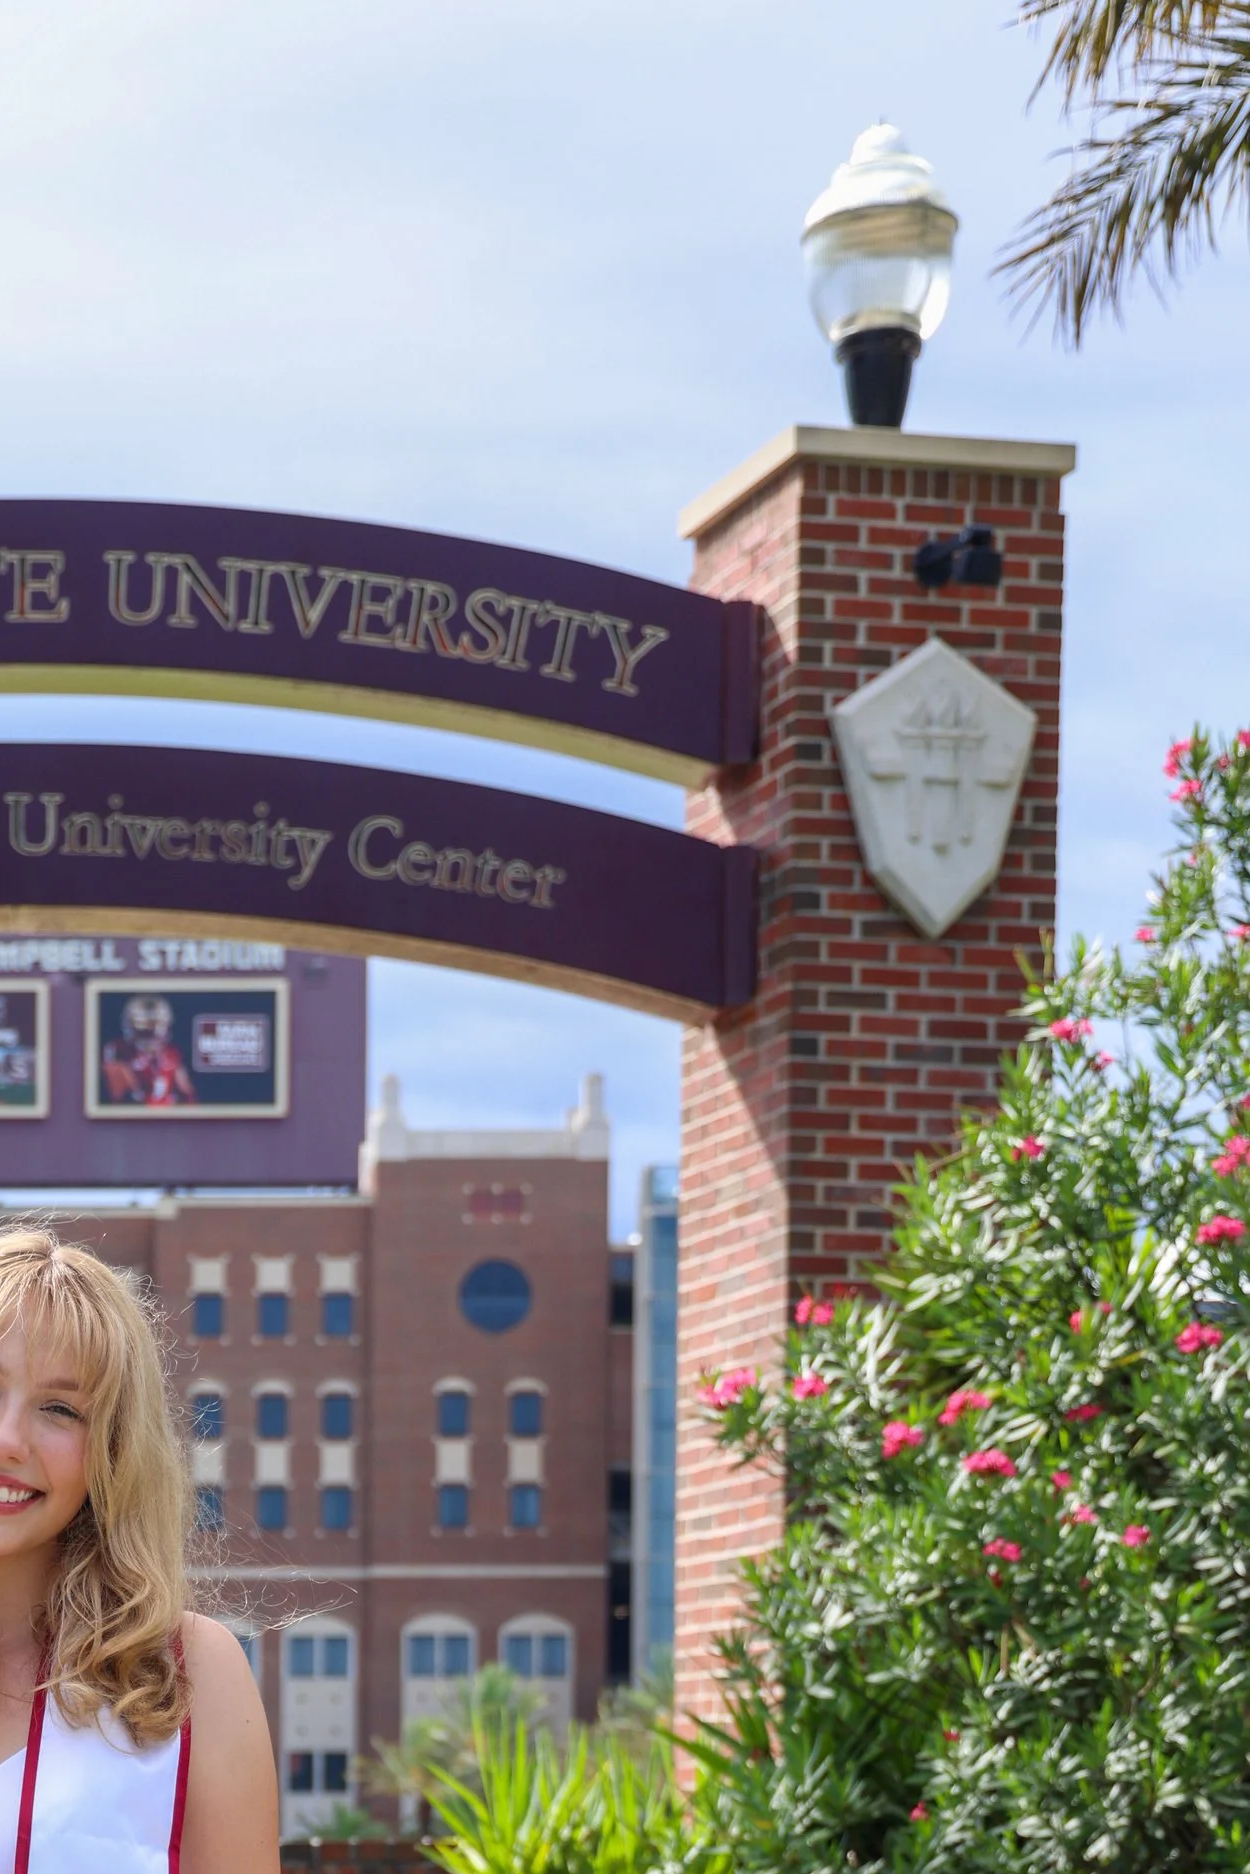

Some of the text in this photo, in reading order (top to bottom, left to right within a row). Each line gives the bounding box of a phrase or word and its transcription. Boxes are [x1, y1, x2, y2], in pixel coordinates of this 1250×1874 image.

[104, 550, 670, 696] UNIVERSITY
[5, 792, 332, 891] University
[349, 815, 566, 909] Center
[138, 938, 285, 971] STADIUM
